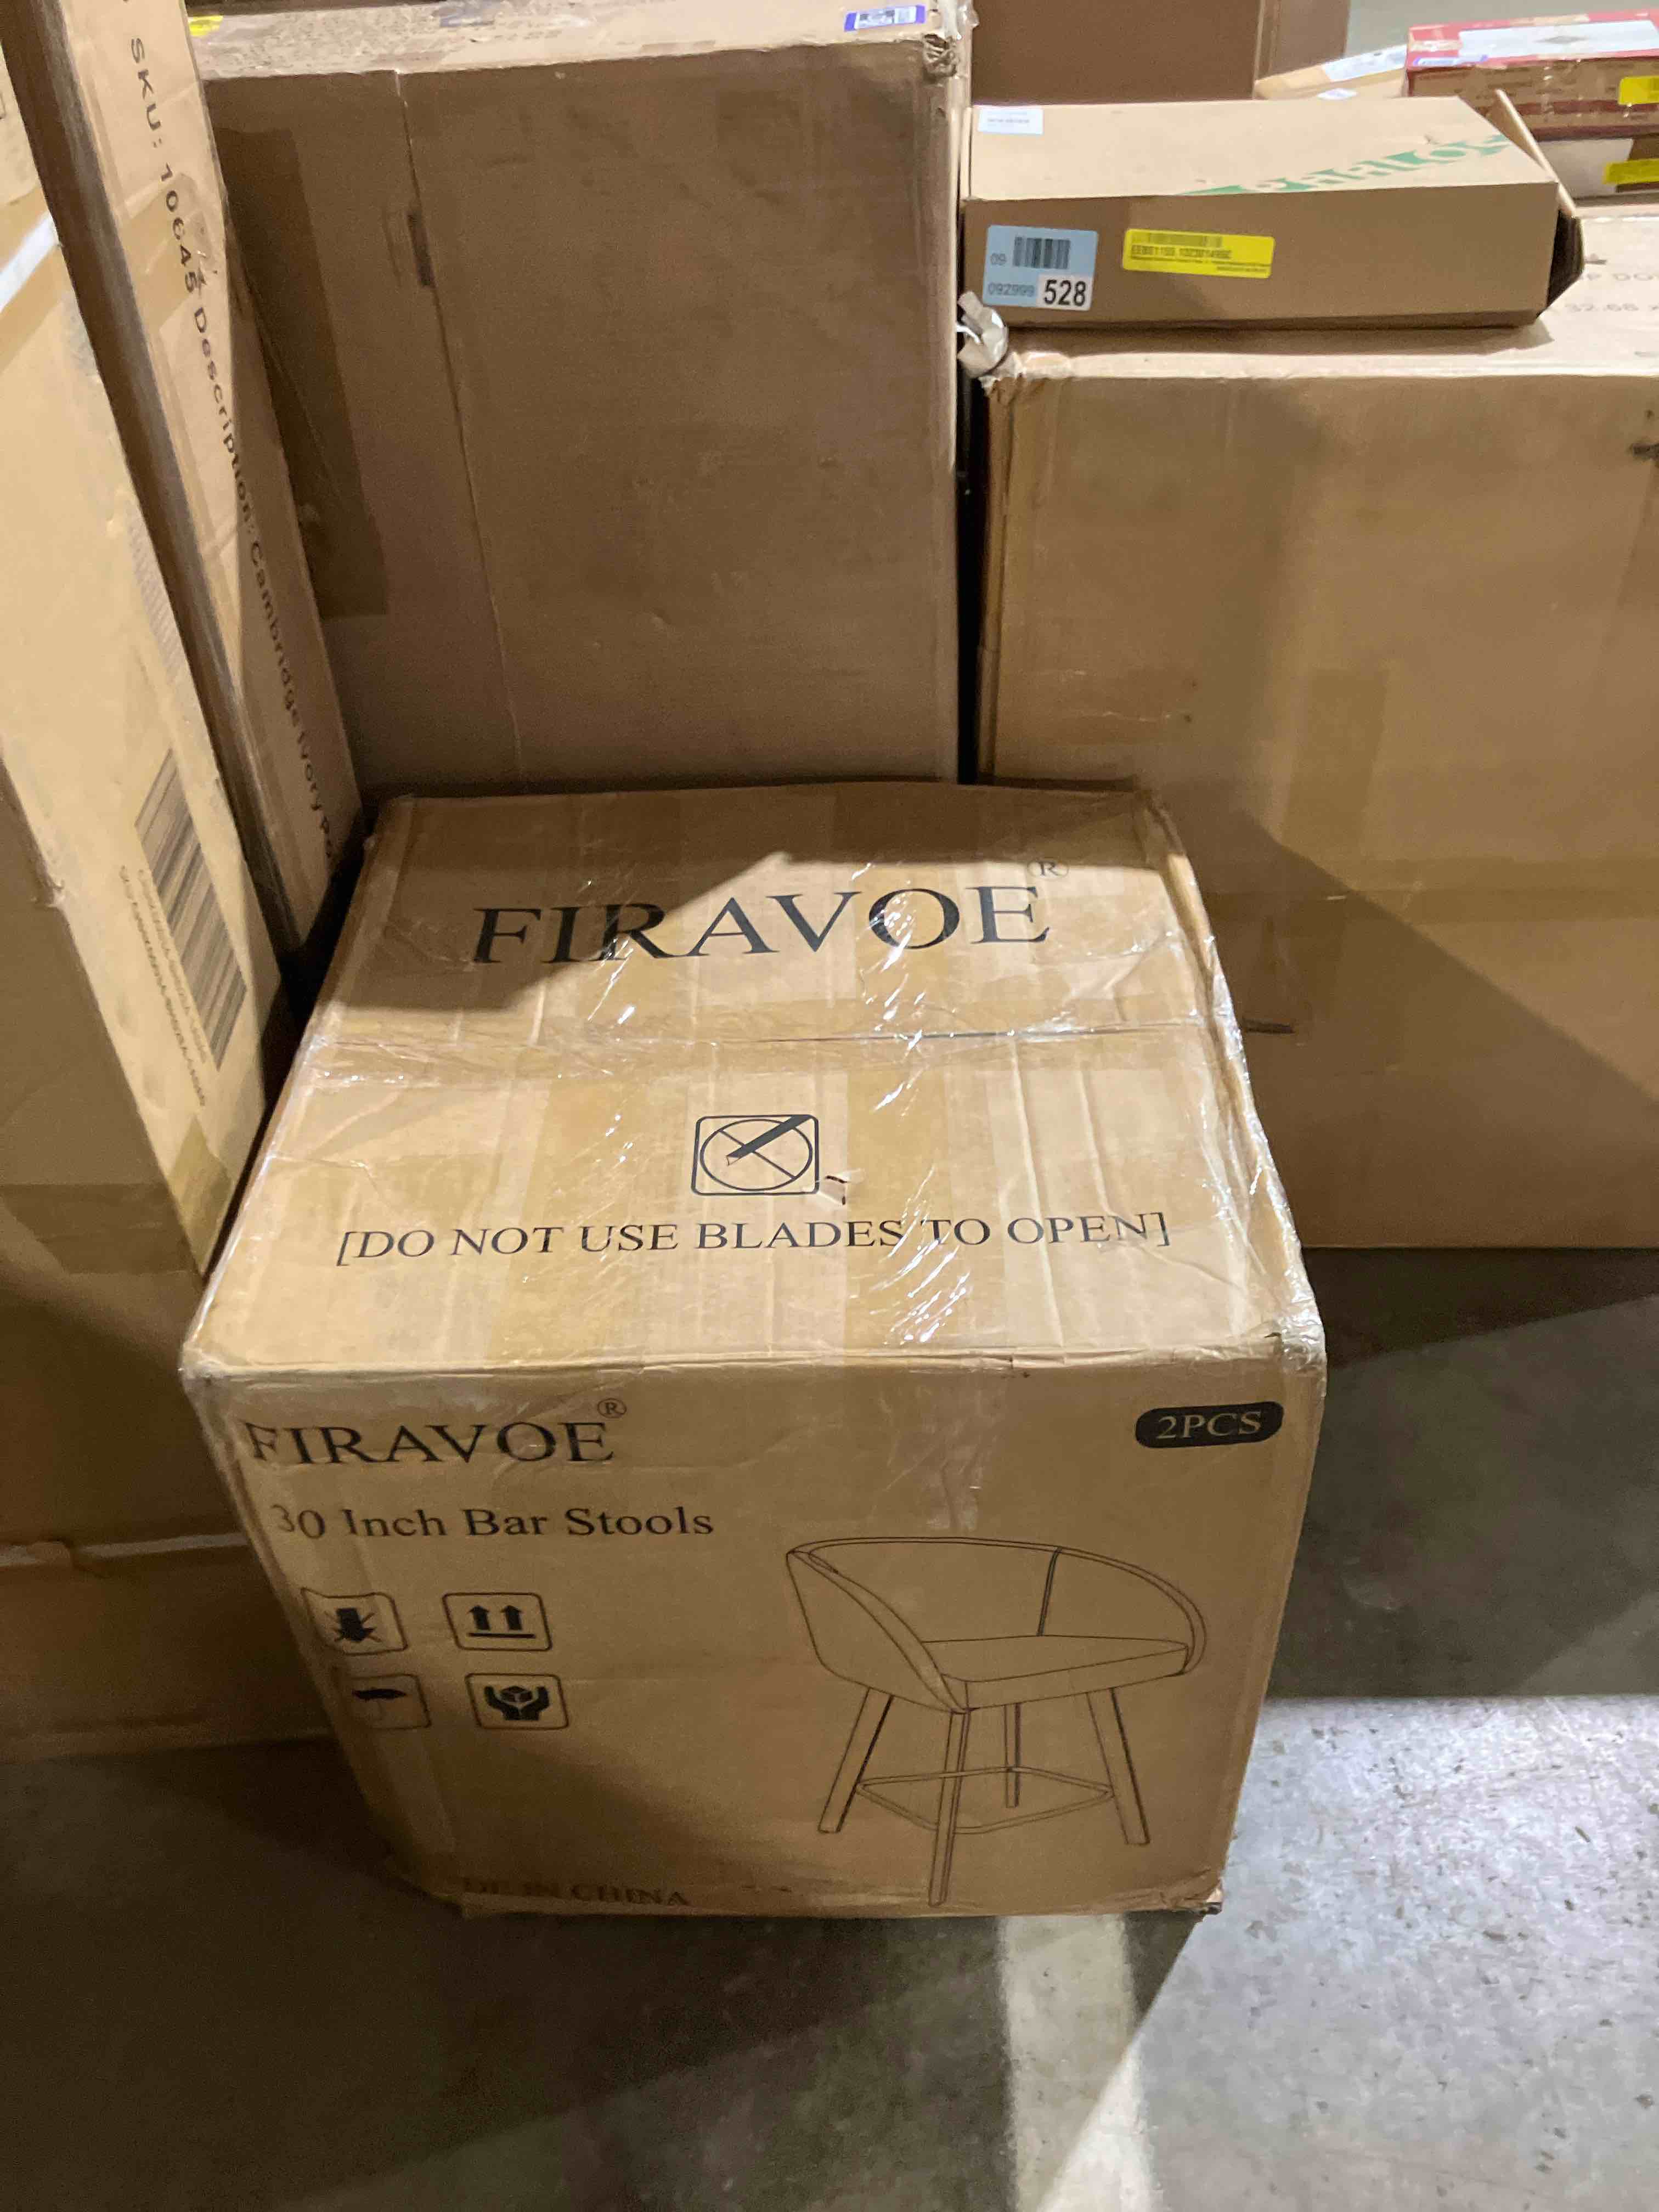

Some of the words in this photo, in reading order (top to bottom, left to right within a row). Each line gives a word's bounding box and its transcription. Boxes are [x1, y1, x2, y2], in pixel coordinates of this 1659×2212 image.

[131, 38, 163, 148] SKU:
[1043, 279, 1087, 307] 528
[473, 885, 1051, 964] FIRAVOE
[336, 1229, 435, 1267] [DO
[450, 1226, 563, 1256] NOT
[580, 1223, 679, 1253] USE
[695, 1219, 904, 1249] BLADES
[921, 1217, 991, 1246] TO
[1007, 1211, 1172, 1247] OPEN]
[244, 1421, 615, 1465] FIRAVOE
[1155, 1410, 1262, 1440] 2PCS
[270, 1504, 325, 1539] 30
[341, 1508, 445, 1537] Inch
[461, 1508, 548, 1537] Bar
[565, 1506, 715, 1536] Stools
[571, 1883, 690, 1906] CHINA
